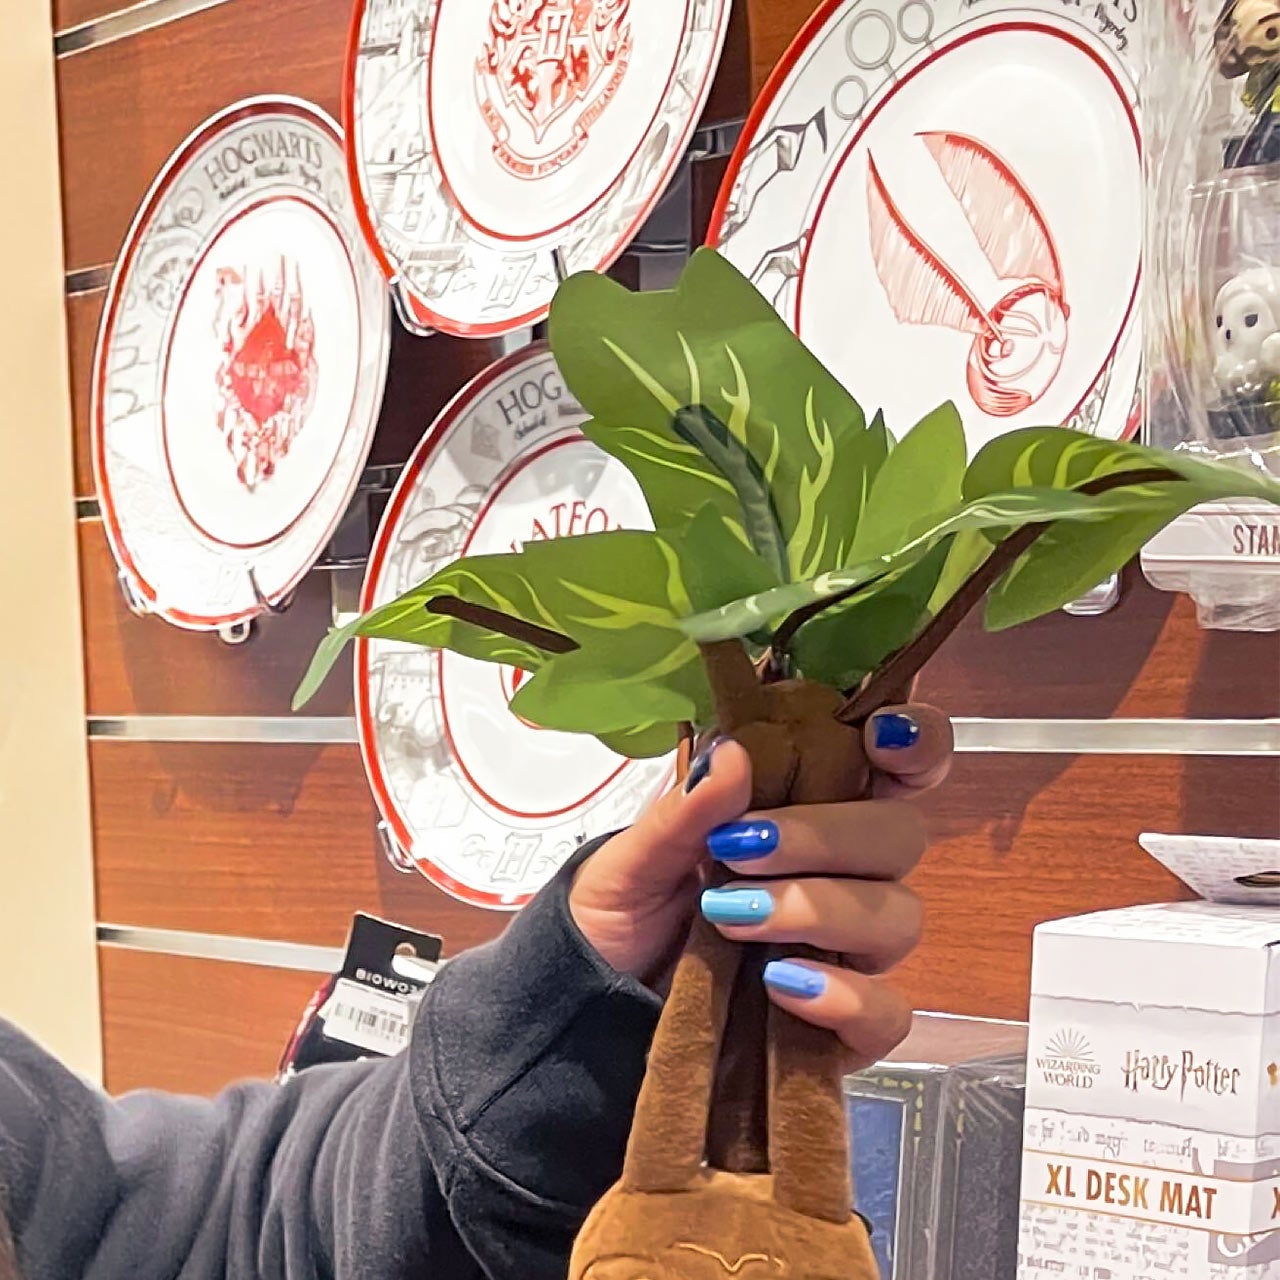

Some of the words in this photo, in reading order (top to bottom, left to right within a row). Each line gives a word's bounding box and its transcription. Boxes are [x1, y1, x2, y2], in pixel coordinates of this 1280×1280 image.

[204, 130, 322, 190] HOGWARTS
[1036, 1057, 1101, 1075] WIZARDING
[1043, 1071, 1093, 1089] WORLD
[1122, 1049, 1178, 1092] Harry
[1181, 1049, 1241, 1102] Potter
[1045, 1163, 1076, 1197] XL
[1085, 1168, 1149, 1210] DESK
[1159, 1180, 1217, 1219] MAT
